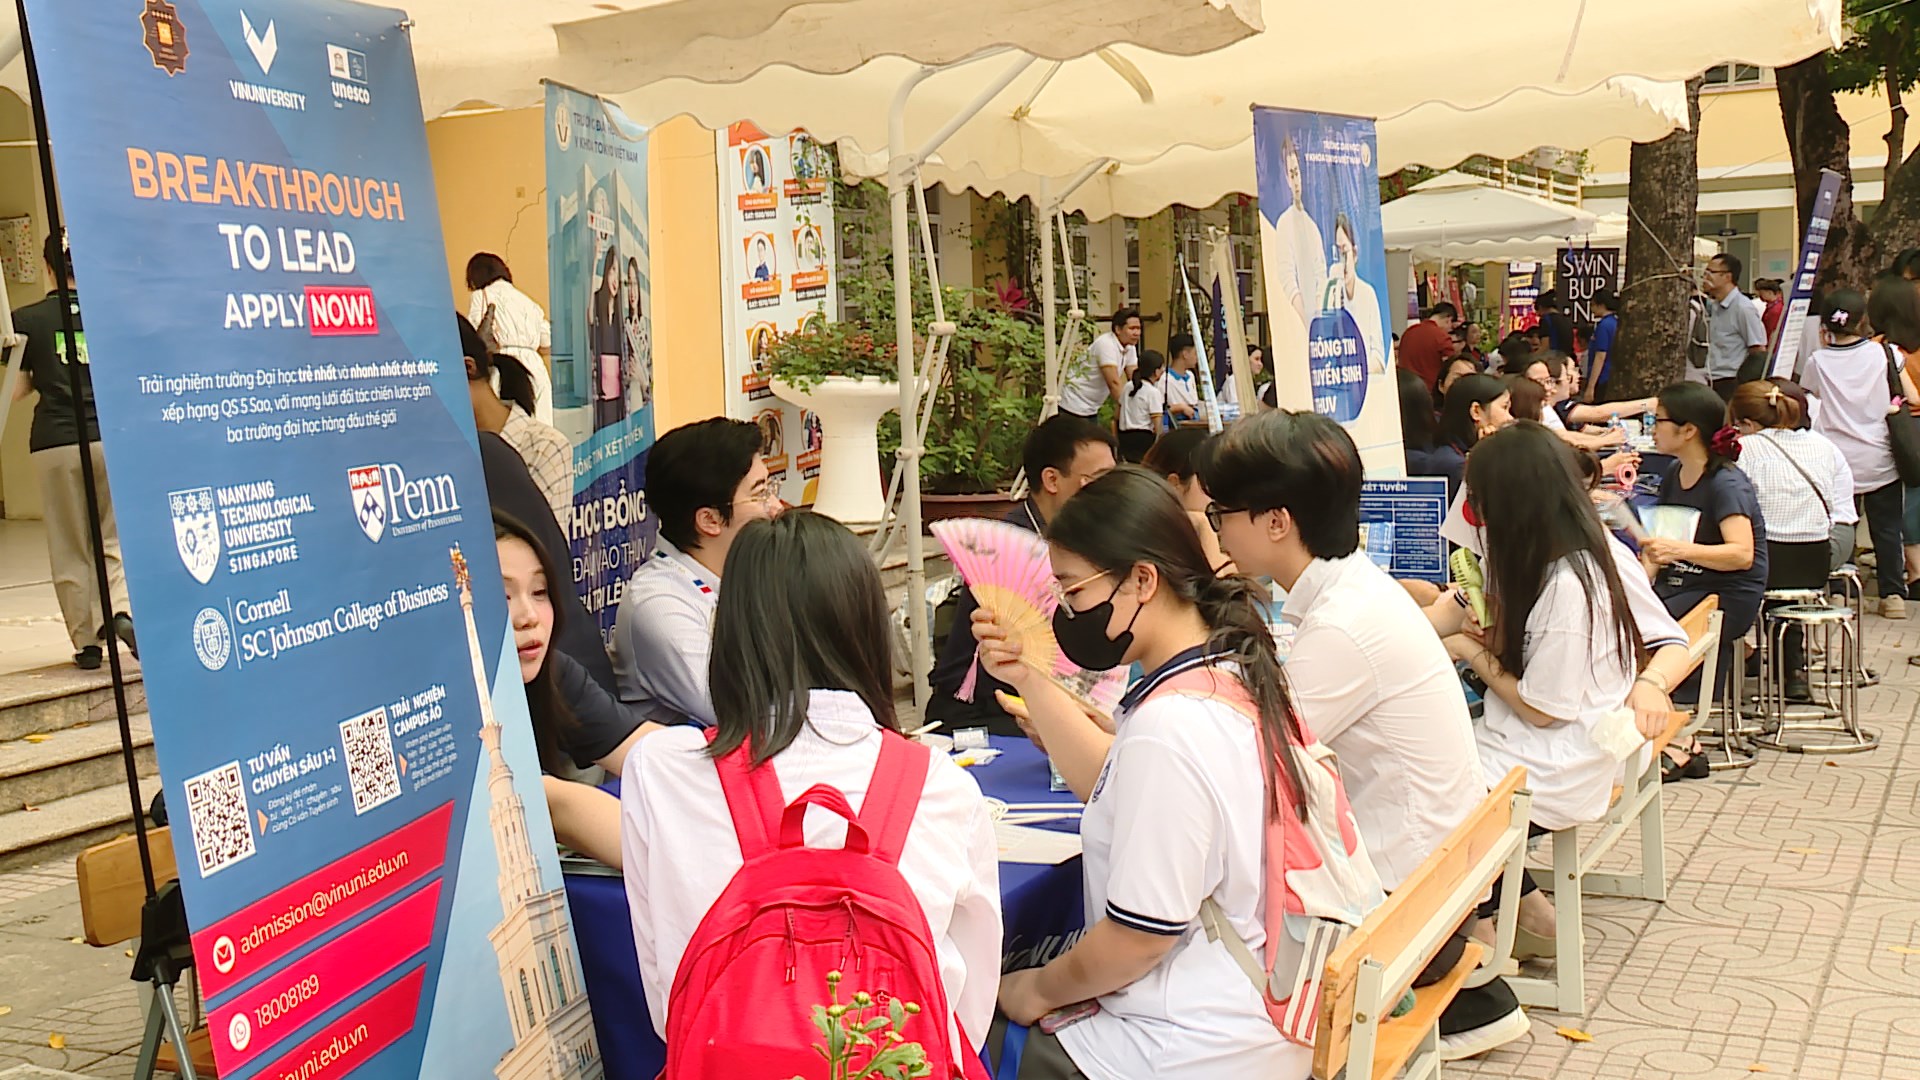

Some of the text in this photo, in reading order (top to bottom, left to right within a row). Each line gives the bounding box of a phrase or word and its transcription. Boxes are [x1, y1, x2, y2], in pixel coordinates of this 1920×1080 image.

[229, 80, 305, 111] VINUNIVERSITY
[331, 81, 370, 105] unesco
[127, 147, 405, 221] BREAKTHROUGH
[219, 223, 356, 274] TO LEAD
[224, 293, 374, 329] APPLY NOW!
[1310, 336, 1357, 359] THÔNG TIN
[138, 359, 438, 396] Trải nghiệm trường Đại học trẻ nhất và nhanh nhất đạt được
[1342, 365, 1363, 383] SINH
[162, 402, 185, 424] xếp
[187, 402, 219, 422] hạng
[222, 398, 238, 418] QS
[240, 399, 248, 414] 5
[250, 397, 273, 414] Sao,
[274, 394, 289, 411] với
[291, 393, 321, 412] mạng
[340, 387, 354, 405] đối
[355, 387, 369, 403] tác
[370, 385, 393, 401] chiến
[395, 385, 412, 402] lược
[227, 426, 243, 443] ba
[244, 423, 281, 441] trường
[283, 419, 301, 438] đại
[302, 418, 320, 436] học
[322, 416, 345, 433] hàng
[366, 410, 380, 425] thế
[381, 408, 397, 428] giới
[573, 455, 592, 478] HÔNG
[605, 437, 623, 458] XÉT
[217, 480, 275, 506] NANYANG
[220, 495, 315, 527] TECHNOLOGICAL
[381, 463, 461, 524] Penn
[572, 479, 646, 547] HỌC BỔNG
[224, 517, 292, 548] UNIVERSITY
[230, 545, 298, 574] SINGAPORE
[236, 588, 292, 624] Cornell
[242, 631, 268, 661] SC
[269, 619, 333, 660] Johnson
[334, 602, 383, 631] College
[384, 591, 398, 617] of
[398, 583, 449, 613] Business
[390, 684, 446, 719] TRẢI NGHIỆM
[394, 703, 442, 737] CAMPUS ẢO
[247, 743, 290, 775] TƯ VẤN
[252, 747, 337, 795] CHUYÊN SÂU 1-1
[239, 851, 409, 954] admission@vinuni.edu.vn
[254, 974, 320, 1028] 18008189
